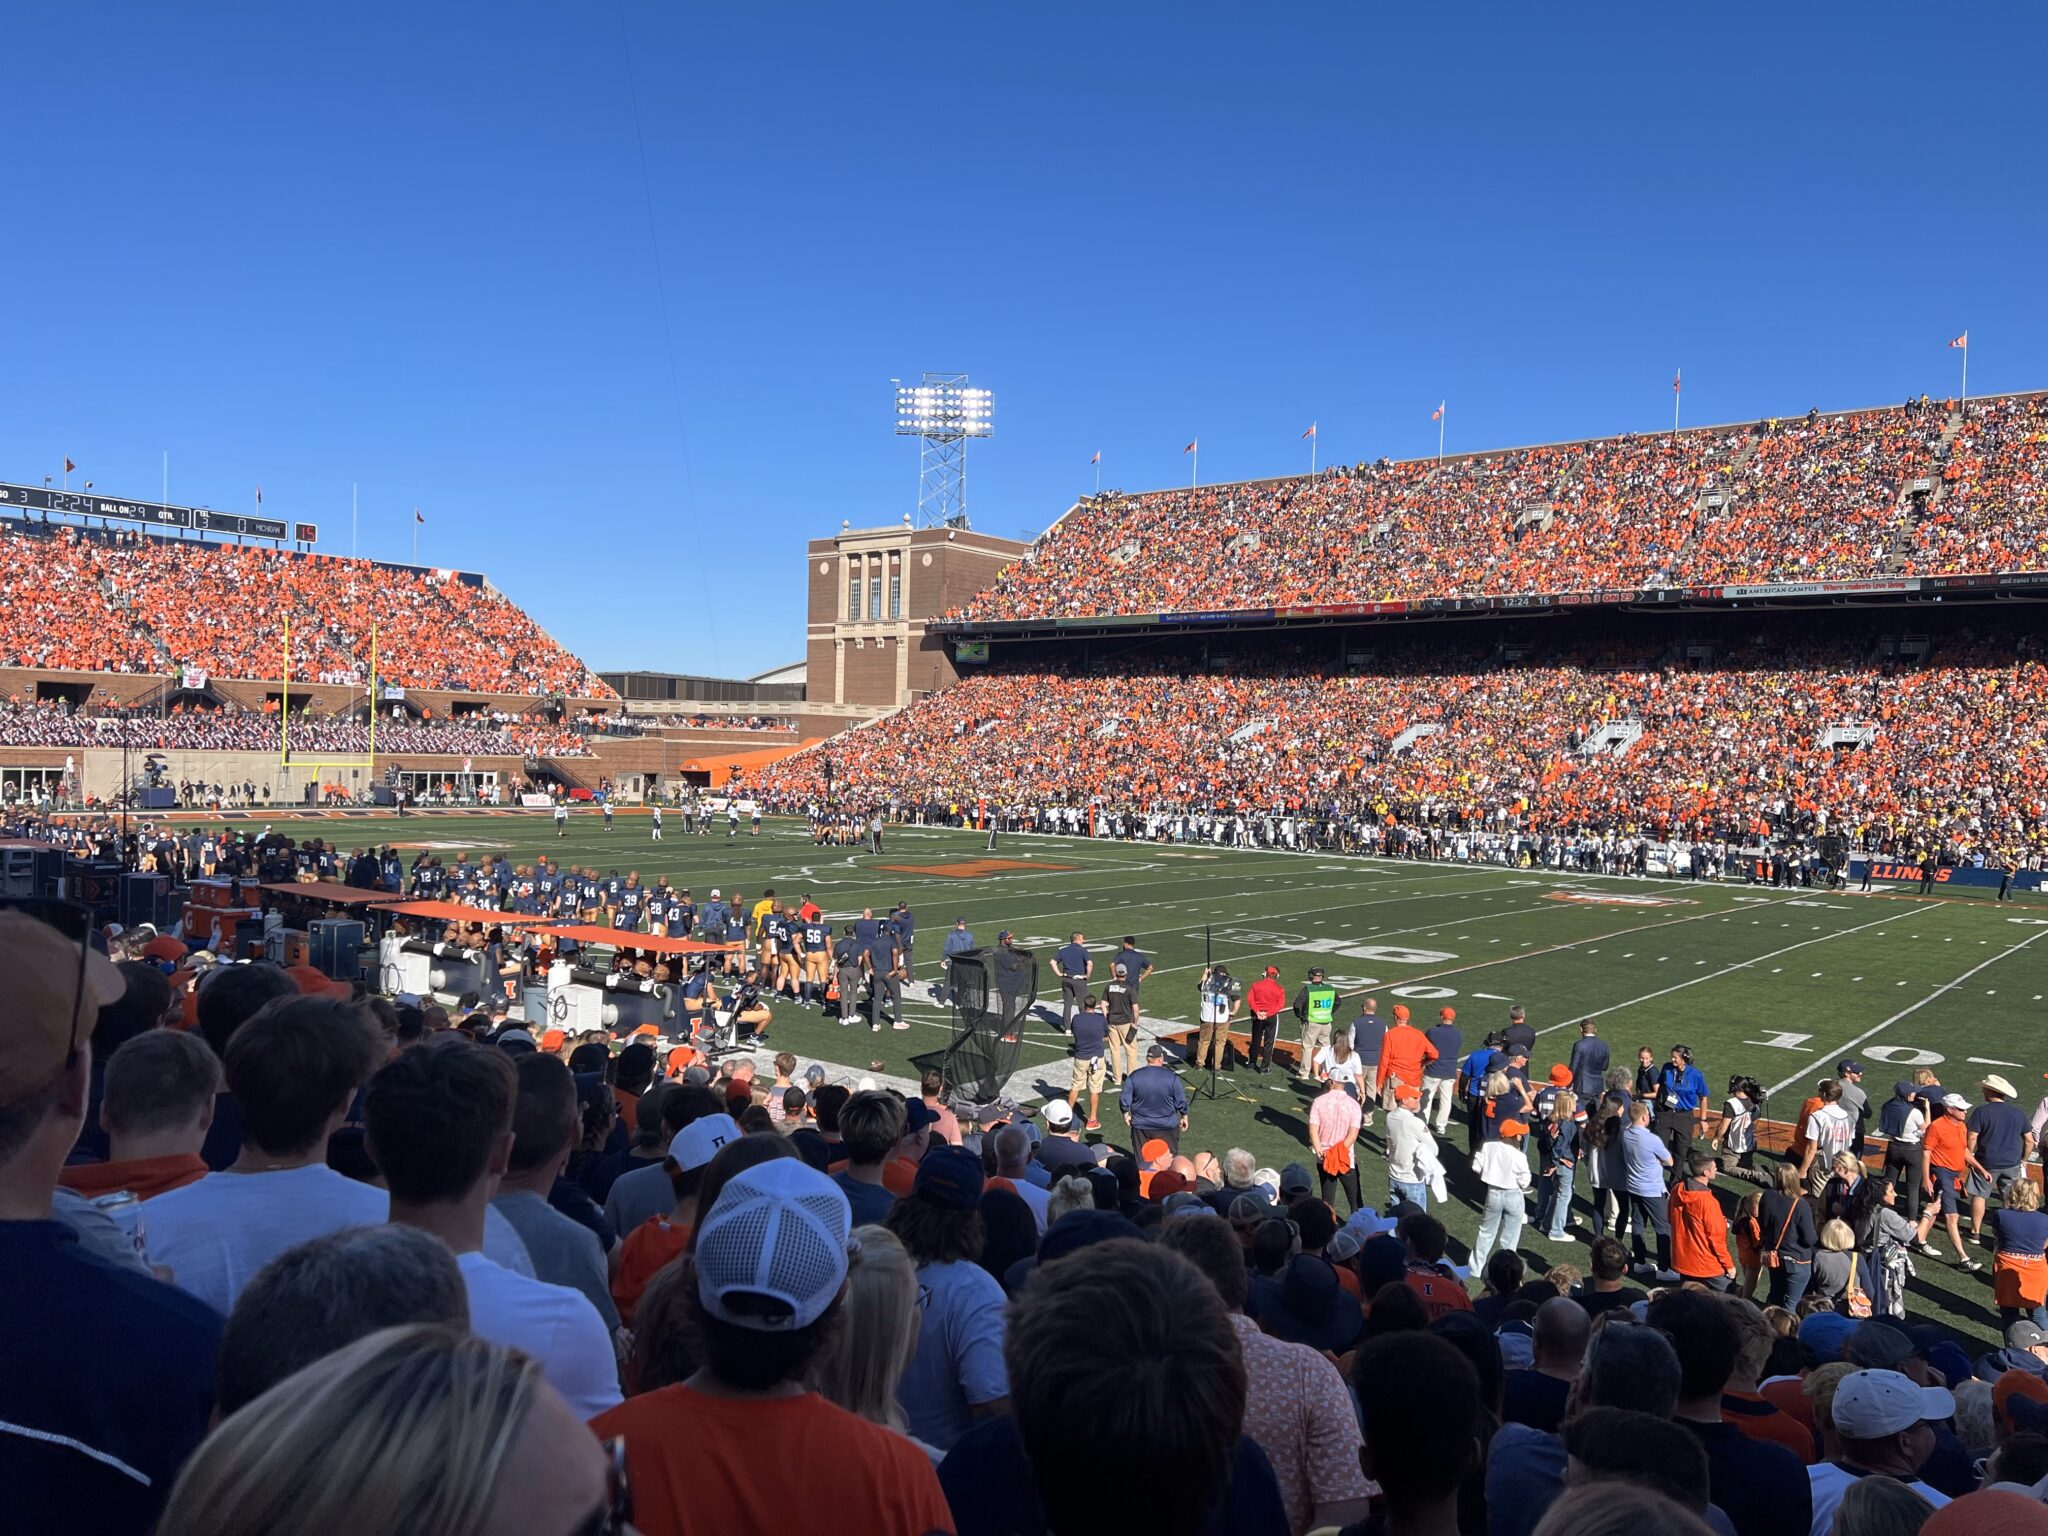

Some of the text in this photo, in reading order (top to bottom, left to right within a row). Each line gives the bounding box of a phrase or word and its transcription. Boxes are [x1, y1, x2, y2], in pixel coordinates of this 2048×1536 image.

[48, 493, 94, 512] 12:24
[100, 503, 145, 518] BALL ON 29
[237, 518, 247, 533] 0
[301, 526, 316, 541] 15
[1788, 585, 1818, 593] CAMPUS
[1503, 597, 1530, 606] 12:24
[1538, 596, 1550, 605] 16
[1602, 593, 1620, 603] ON
[384, 862, 394, 874] 14
[420, 871, 431, 883] 12
[478, 880, 490, 891] 32
[541, 880, 552, 892] 19
[583, 886, 596, 898] 44
[610, 881, 618, 893] 2
[478, 898, 490, 911] 34
[564, 893, 576, 905] 31
[624, 894, 638, 906] 39
[650, 902, 662, 915] 28
[668, 907, 680, 921] 43
[185, 911, 194, 930] G
[806, 929, 821, 944] 56
[503, 980, 517, 999] I
